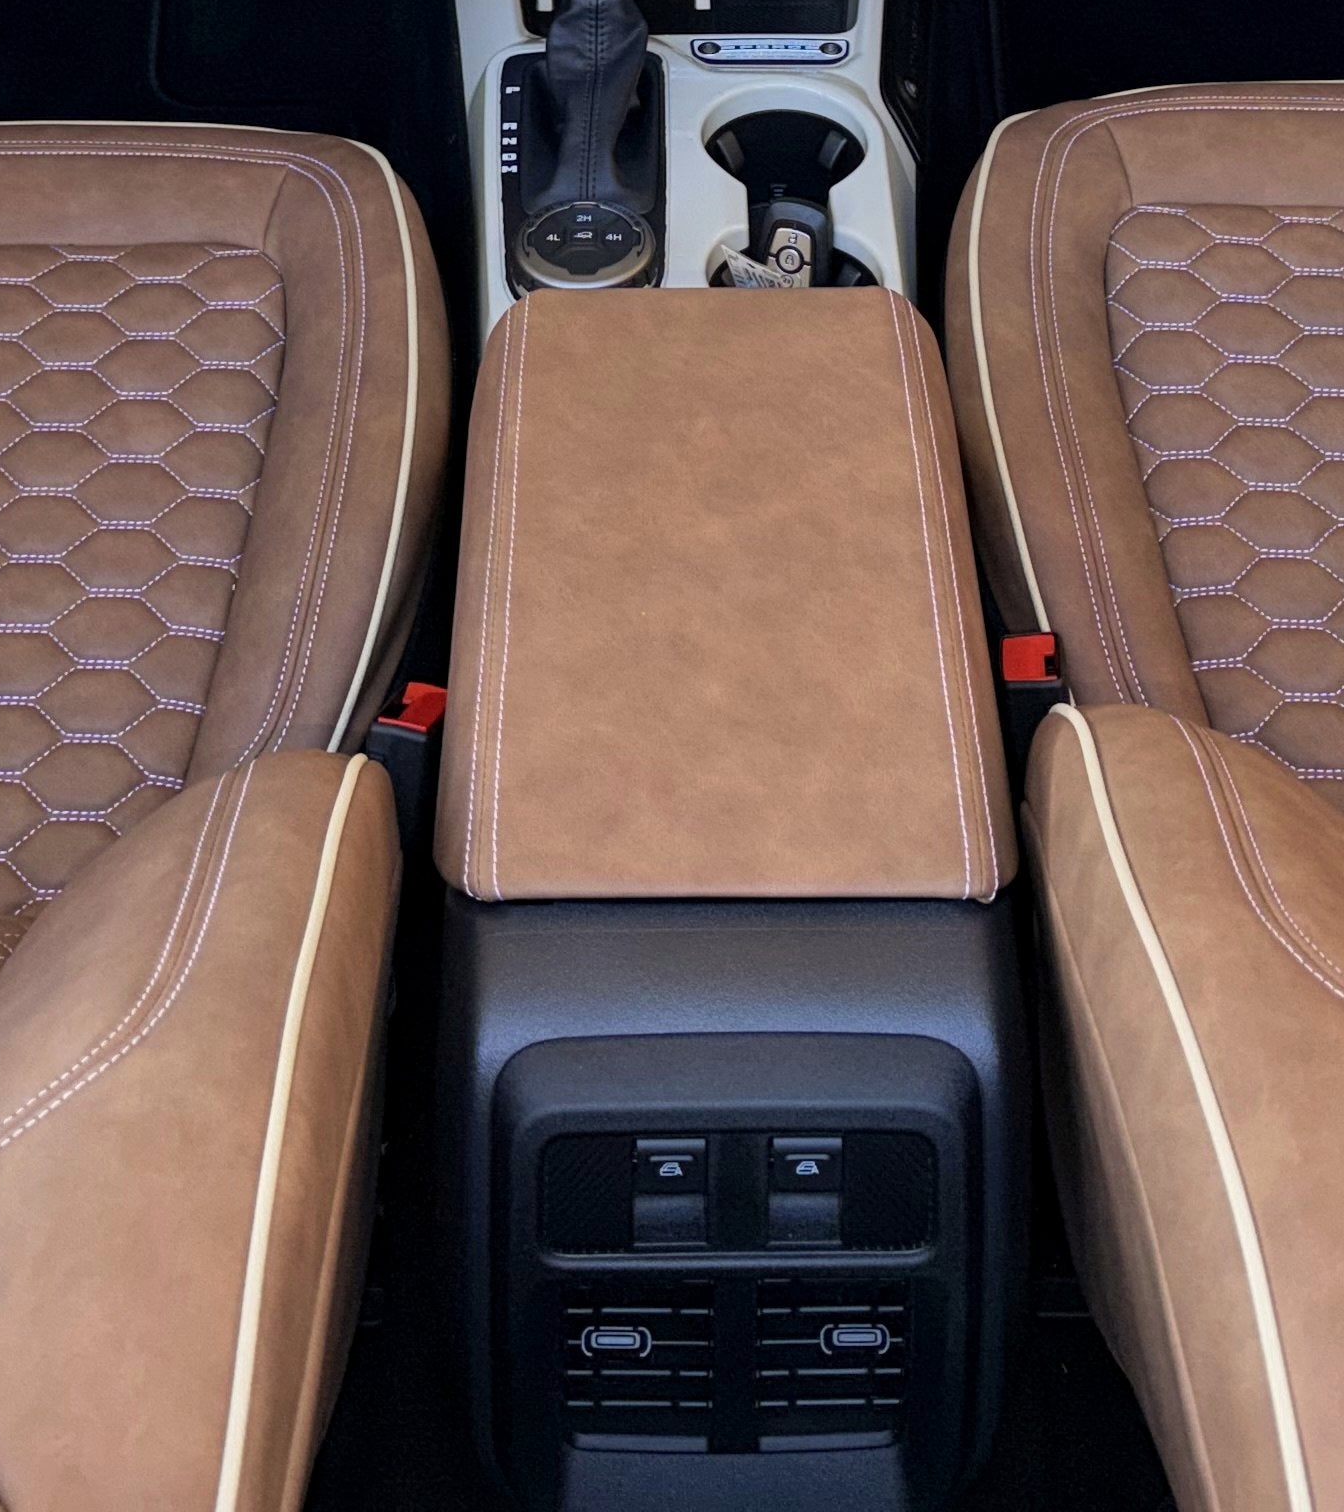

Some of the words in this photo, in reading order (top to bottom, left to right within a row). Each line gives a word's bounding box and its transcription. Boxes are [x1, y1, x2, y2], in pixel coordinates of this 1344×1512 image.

[576, 214, 592, 223] 2H
[545, 233, 561, 242] 4L
[605, 233, 622, 241] 4H
